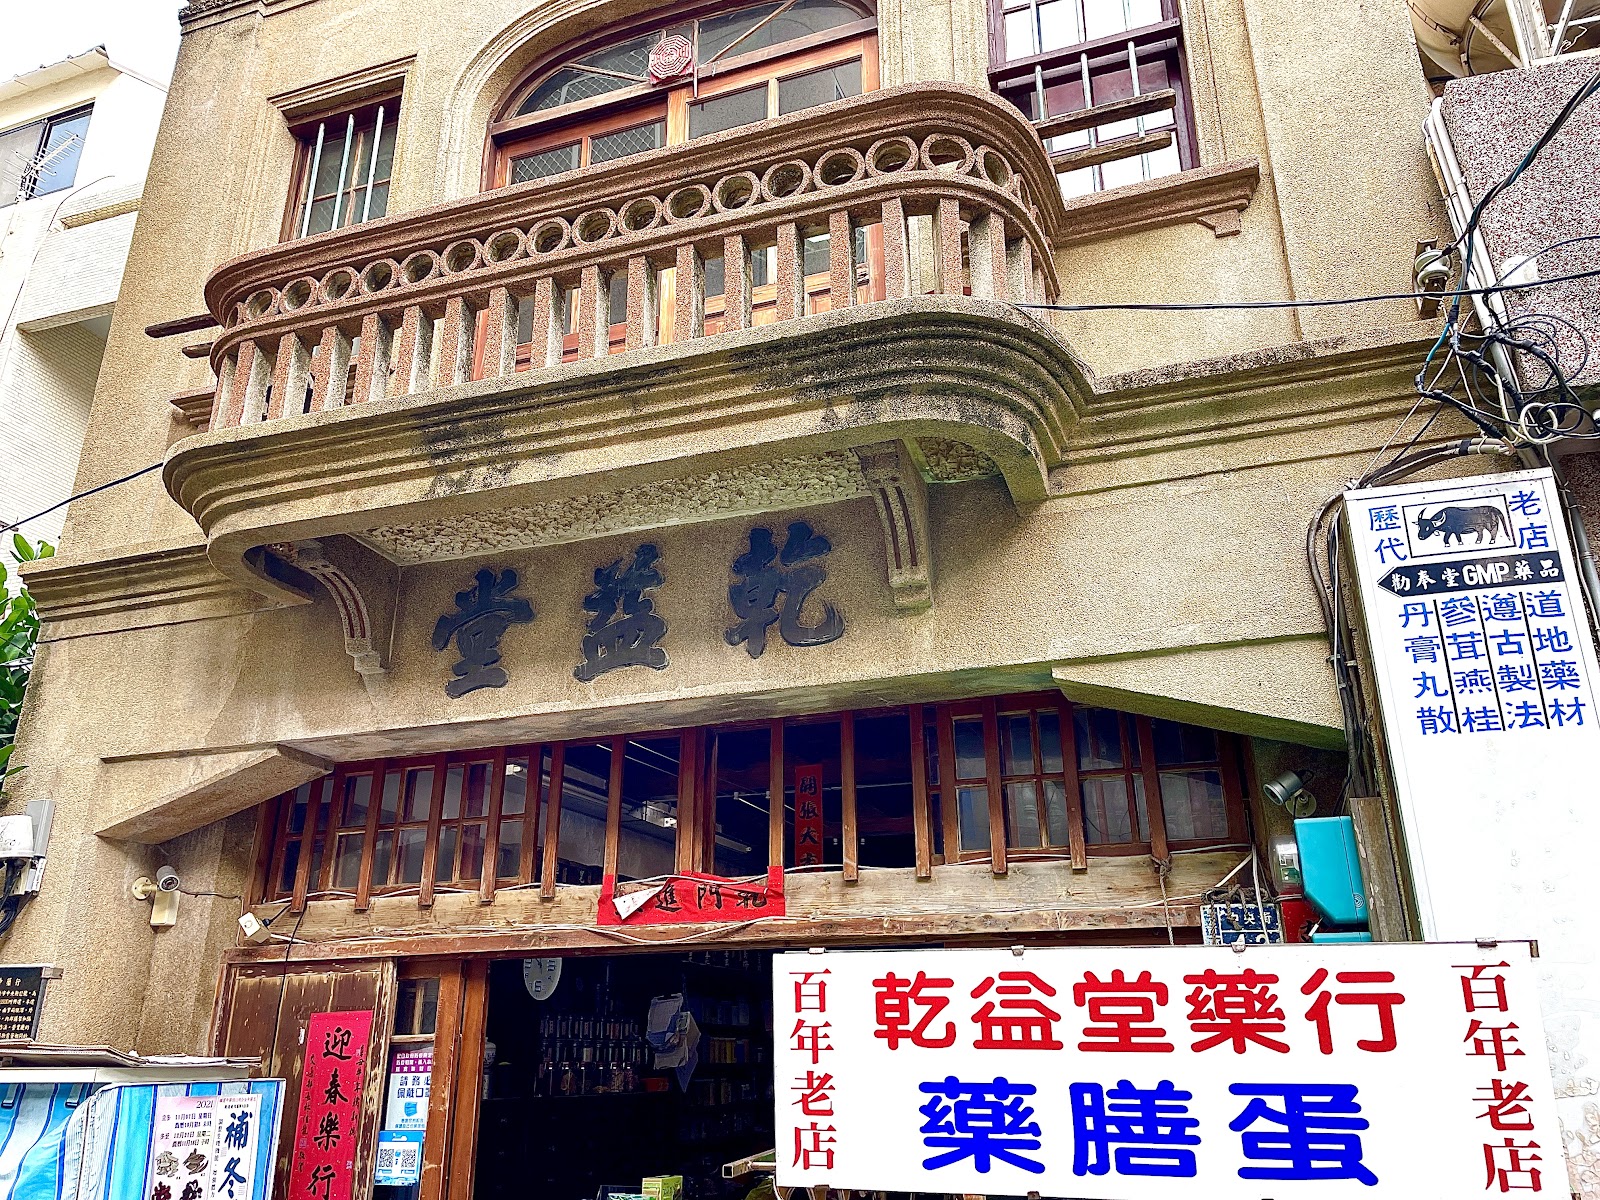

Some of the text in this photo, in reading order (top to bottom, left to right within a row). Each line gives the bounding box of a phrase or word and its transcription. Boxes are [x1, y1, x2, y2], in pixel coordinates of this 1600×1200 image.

[1368, 504, 1408, 564] 歷代
[1508, 490, 1549, 550] 老店
[872, 968, 1406, 1055] 乾益堂藥行
[195, 1100, 213, 1109] 2021
[789, 968, 837, 1170] 百年老店
[1451, 961, 1542, 1192] 百年老店
[919, 1076, 1378, 1186] 藥膳蛋
